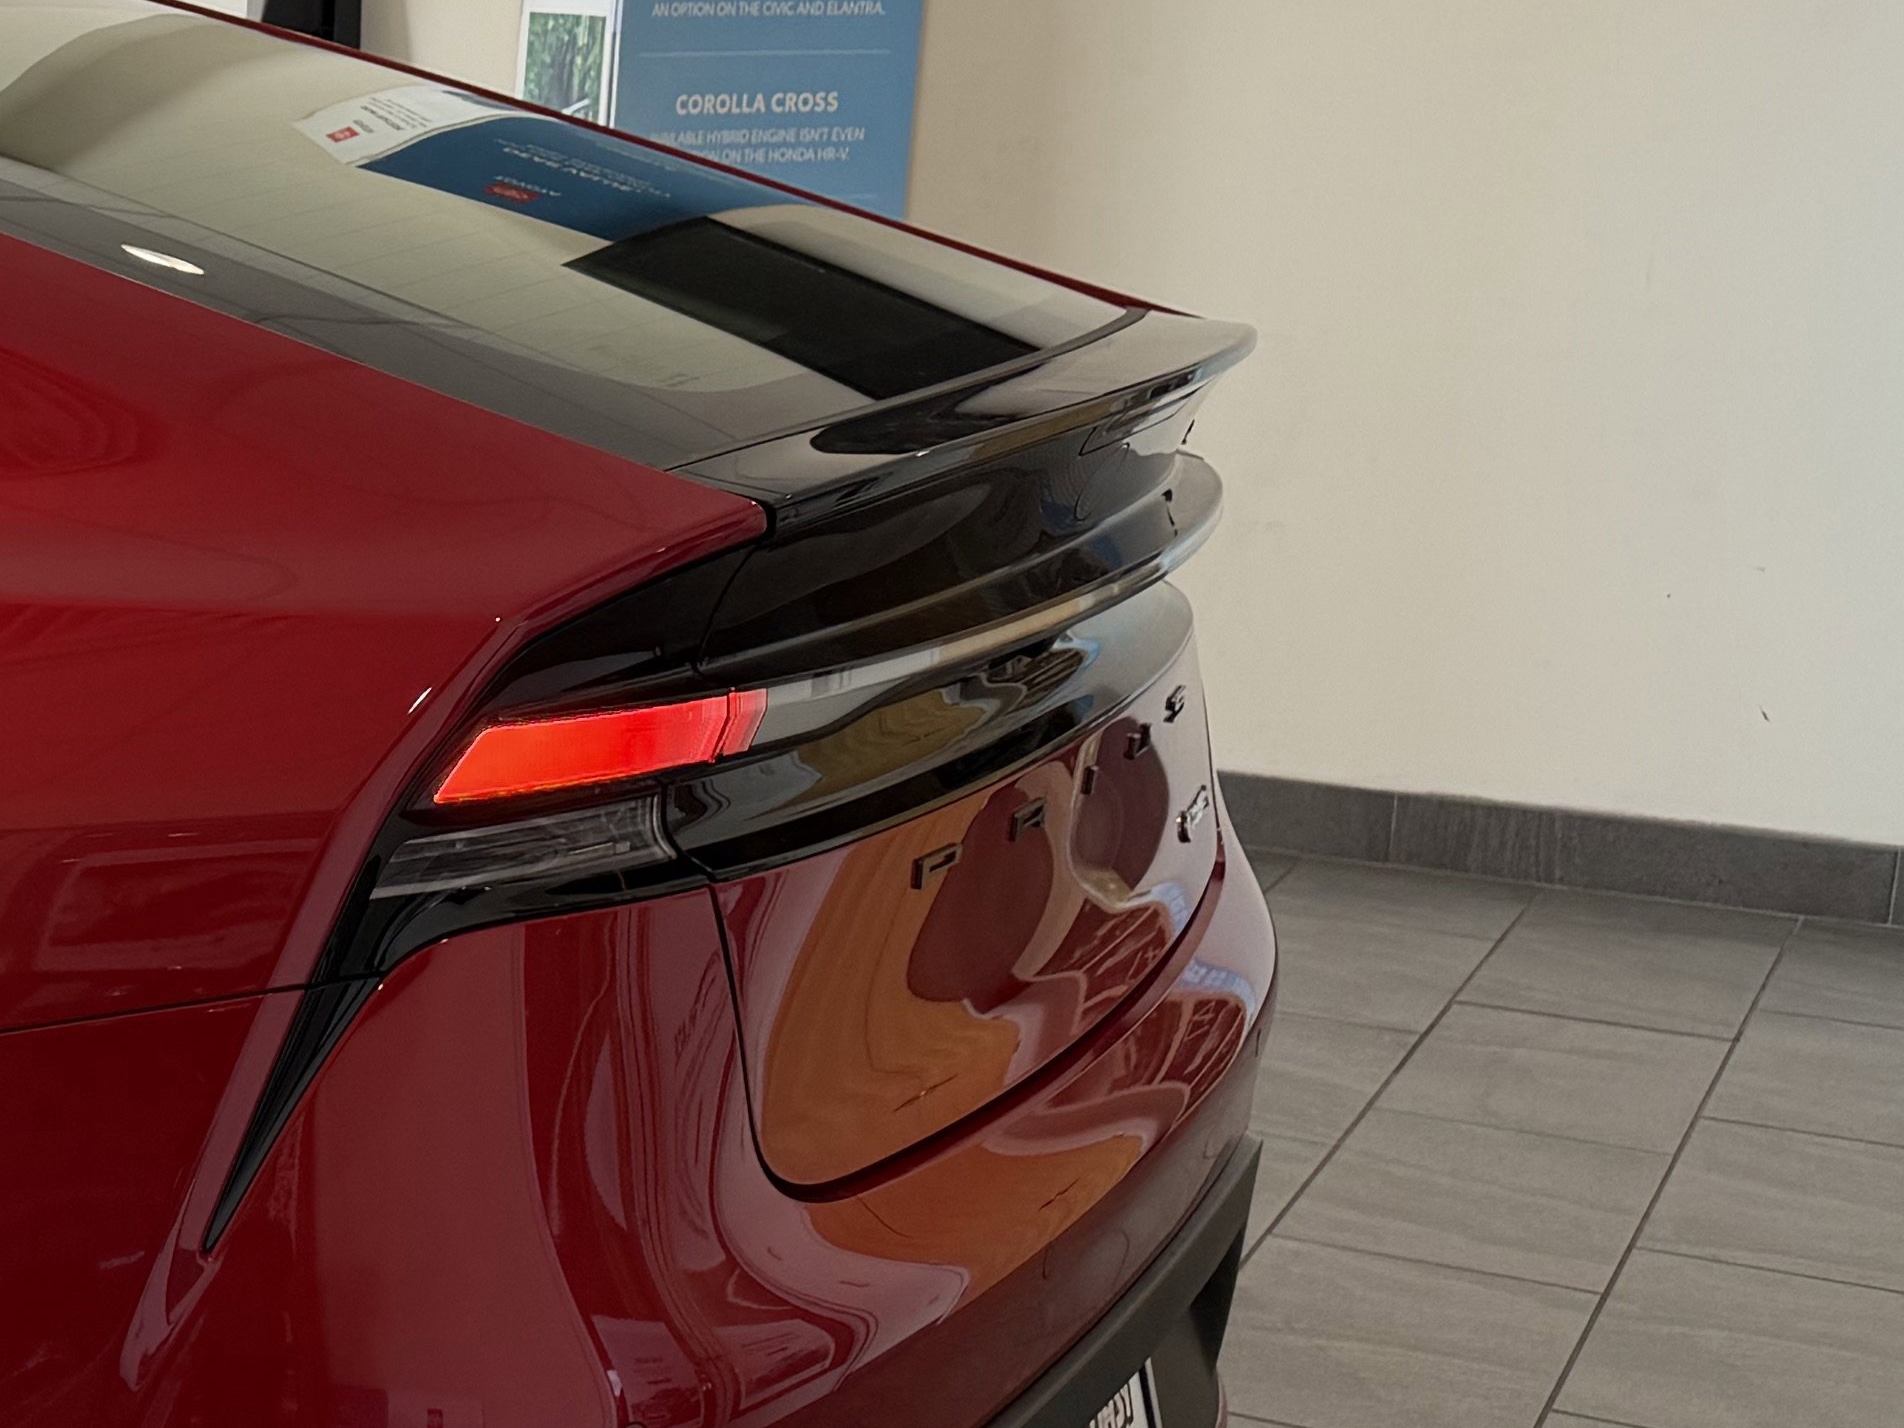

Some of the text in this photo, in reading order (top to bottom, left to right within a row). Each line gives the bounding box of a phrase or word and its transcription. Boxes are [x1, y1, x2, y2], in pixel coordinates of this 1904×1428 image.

[672, 1, 715, 17] OPTION
[717, 1, 737, 17] ON
[794, 0, 823, 16] AND
[676, 91, 838, 116] COROLLA CROSS
